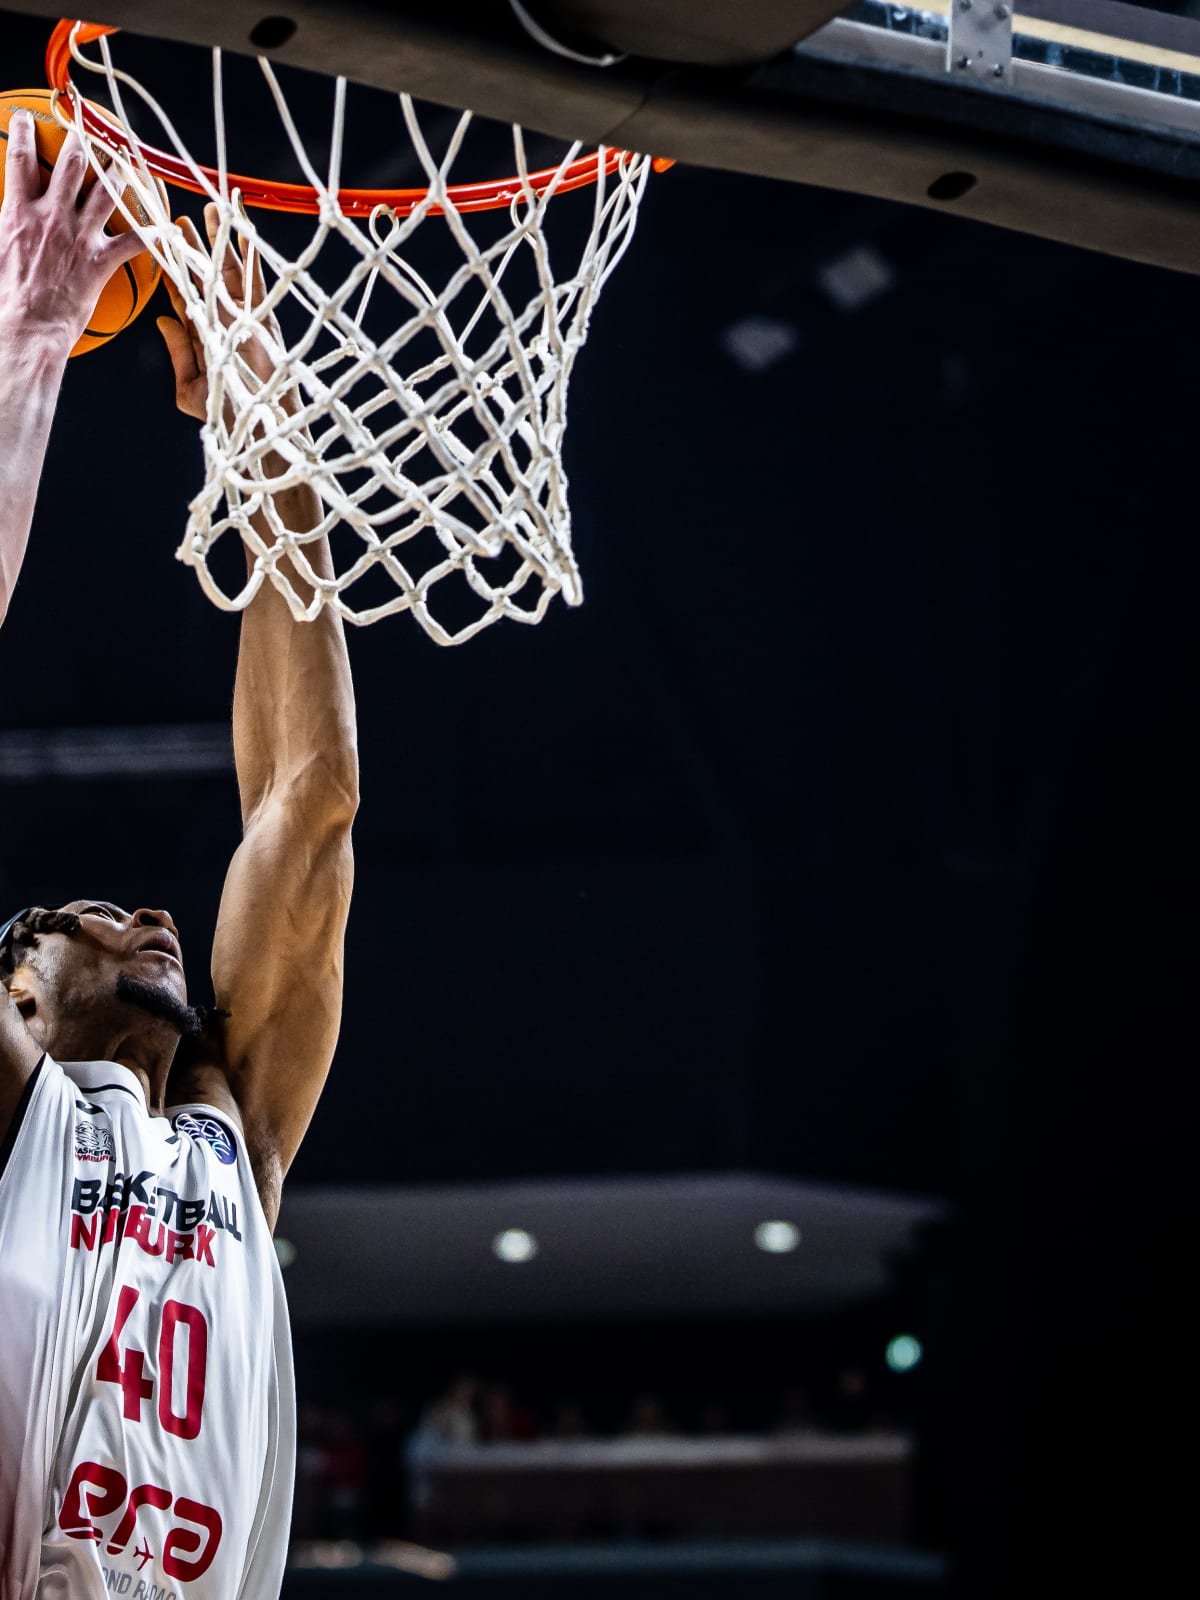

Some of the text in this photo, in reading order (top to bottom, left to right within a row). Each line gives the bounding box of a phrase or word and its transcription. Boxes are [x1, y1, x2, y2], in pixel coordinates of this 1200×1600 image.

[71, 1205, 216, 1268] NBURK
[96, 1285, 208, 1440] 40
[58, 1461, 223, 1583] era
